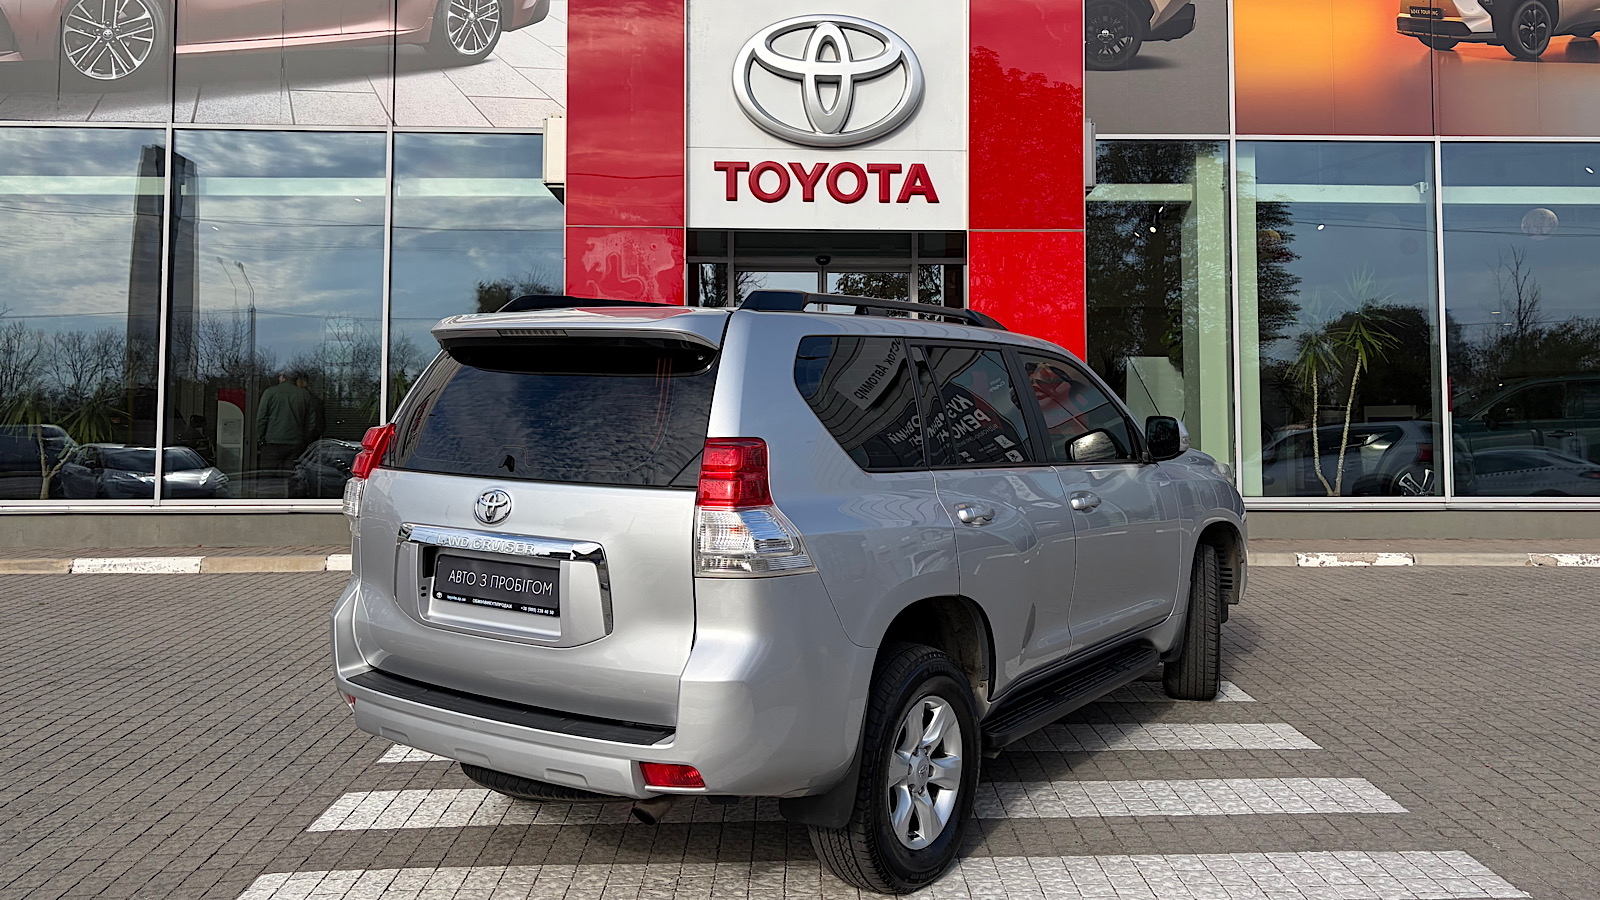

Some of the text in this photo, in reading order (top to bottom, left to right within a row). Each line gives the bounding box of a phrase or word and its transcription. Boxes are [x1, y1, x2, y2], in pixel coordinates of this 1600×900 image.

[714, 160, 940, 204] TOYOTA
[437, 534, 535, 555] LAND CRUISER
[448, 569, 553, 596] АВТО З ПРОБІГОМ
